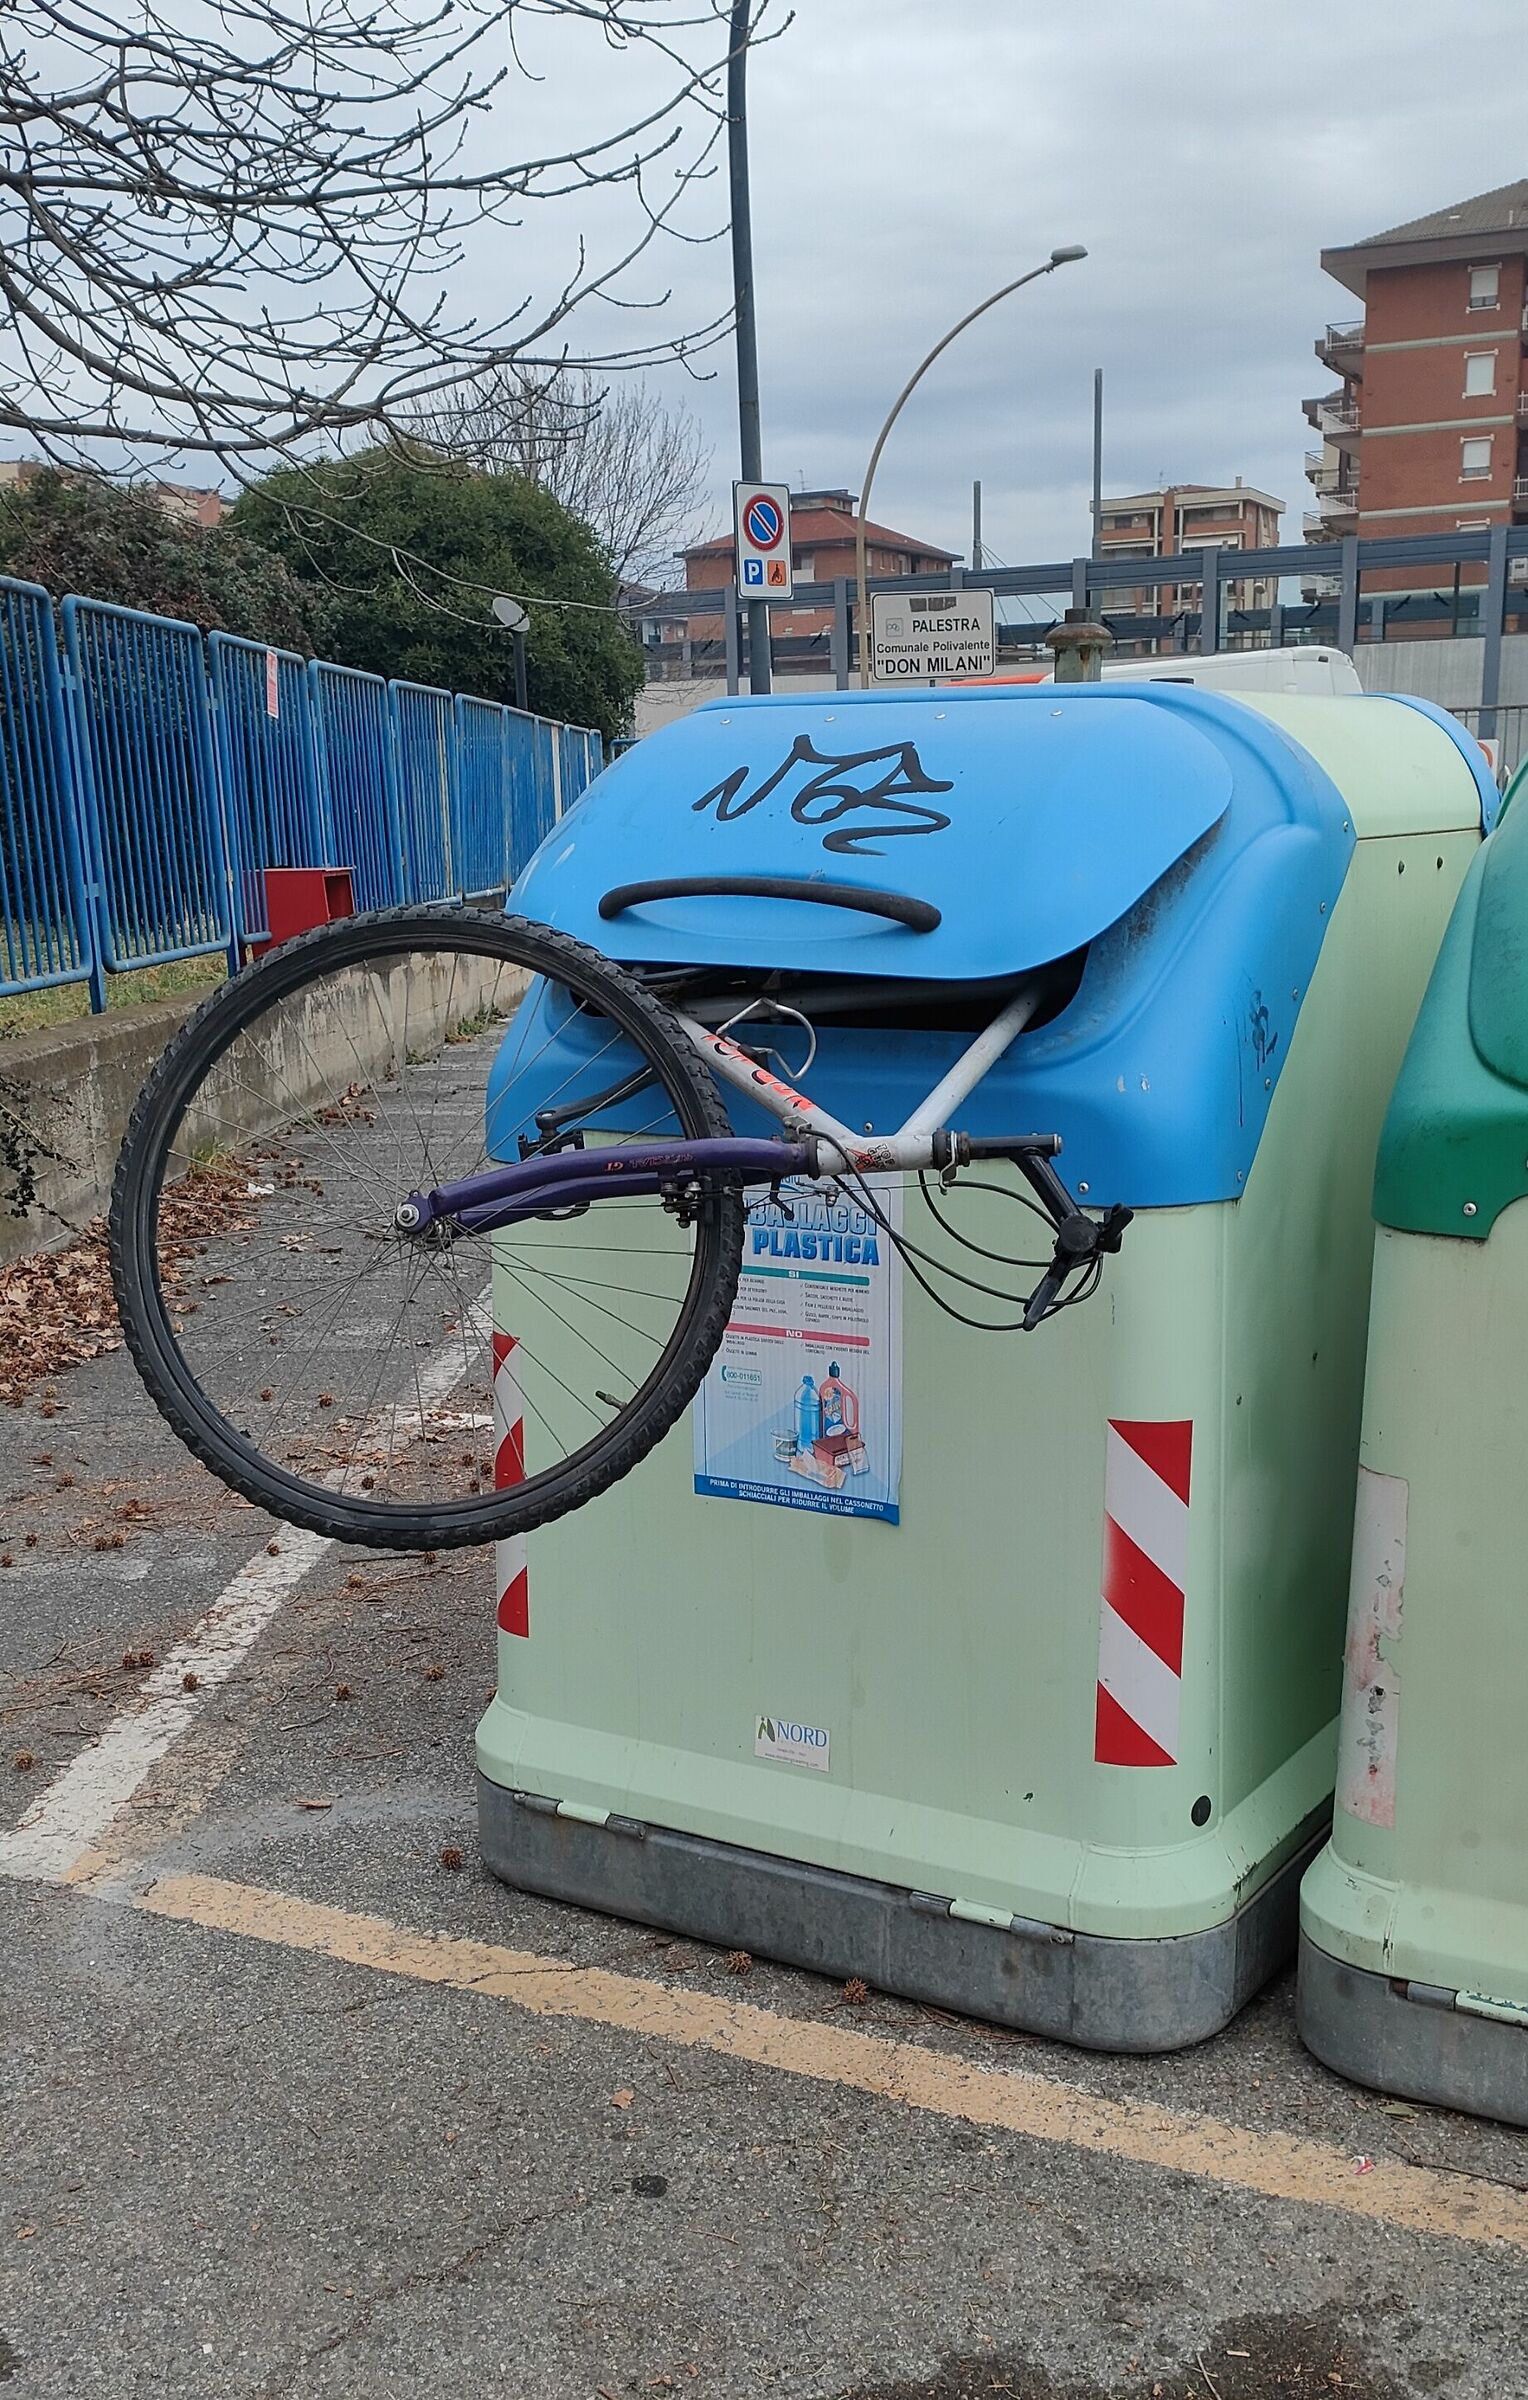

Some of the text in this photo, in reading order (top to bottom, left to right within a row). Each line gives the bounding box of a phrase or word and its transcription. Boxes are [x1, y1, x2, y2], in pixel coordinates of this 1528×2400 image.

[748, 562, 760, 582] P
[912, 618, 980, 633] PALESTRA
[876, 640, 990, 654] Comunale Polivalente
[877, 655, 990, 674] "DON MILANI"
[753, 1227, 880, 1266] PLASTICA
[788, 1270, 800, 1279] SI
[785, 1329, 803, 1339] NO
[709, 1478, 885, 1512] PRIMA DI INTRODURRE GLI IMBALLAGGI NEL CASSONETTO
[777, 1496, 791, 1504] PER
[791, 1497, 822, 1508] RIDURRE
[821, 1502, 829, 1510] IL
[829, 1504, 855, 1514] VOLUME
[777, 1721, 828, 1748] NORD
